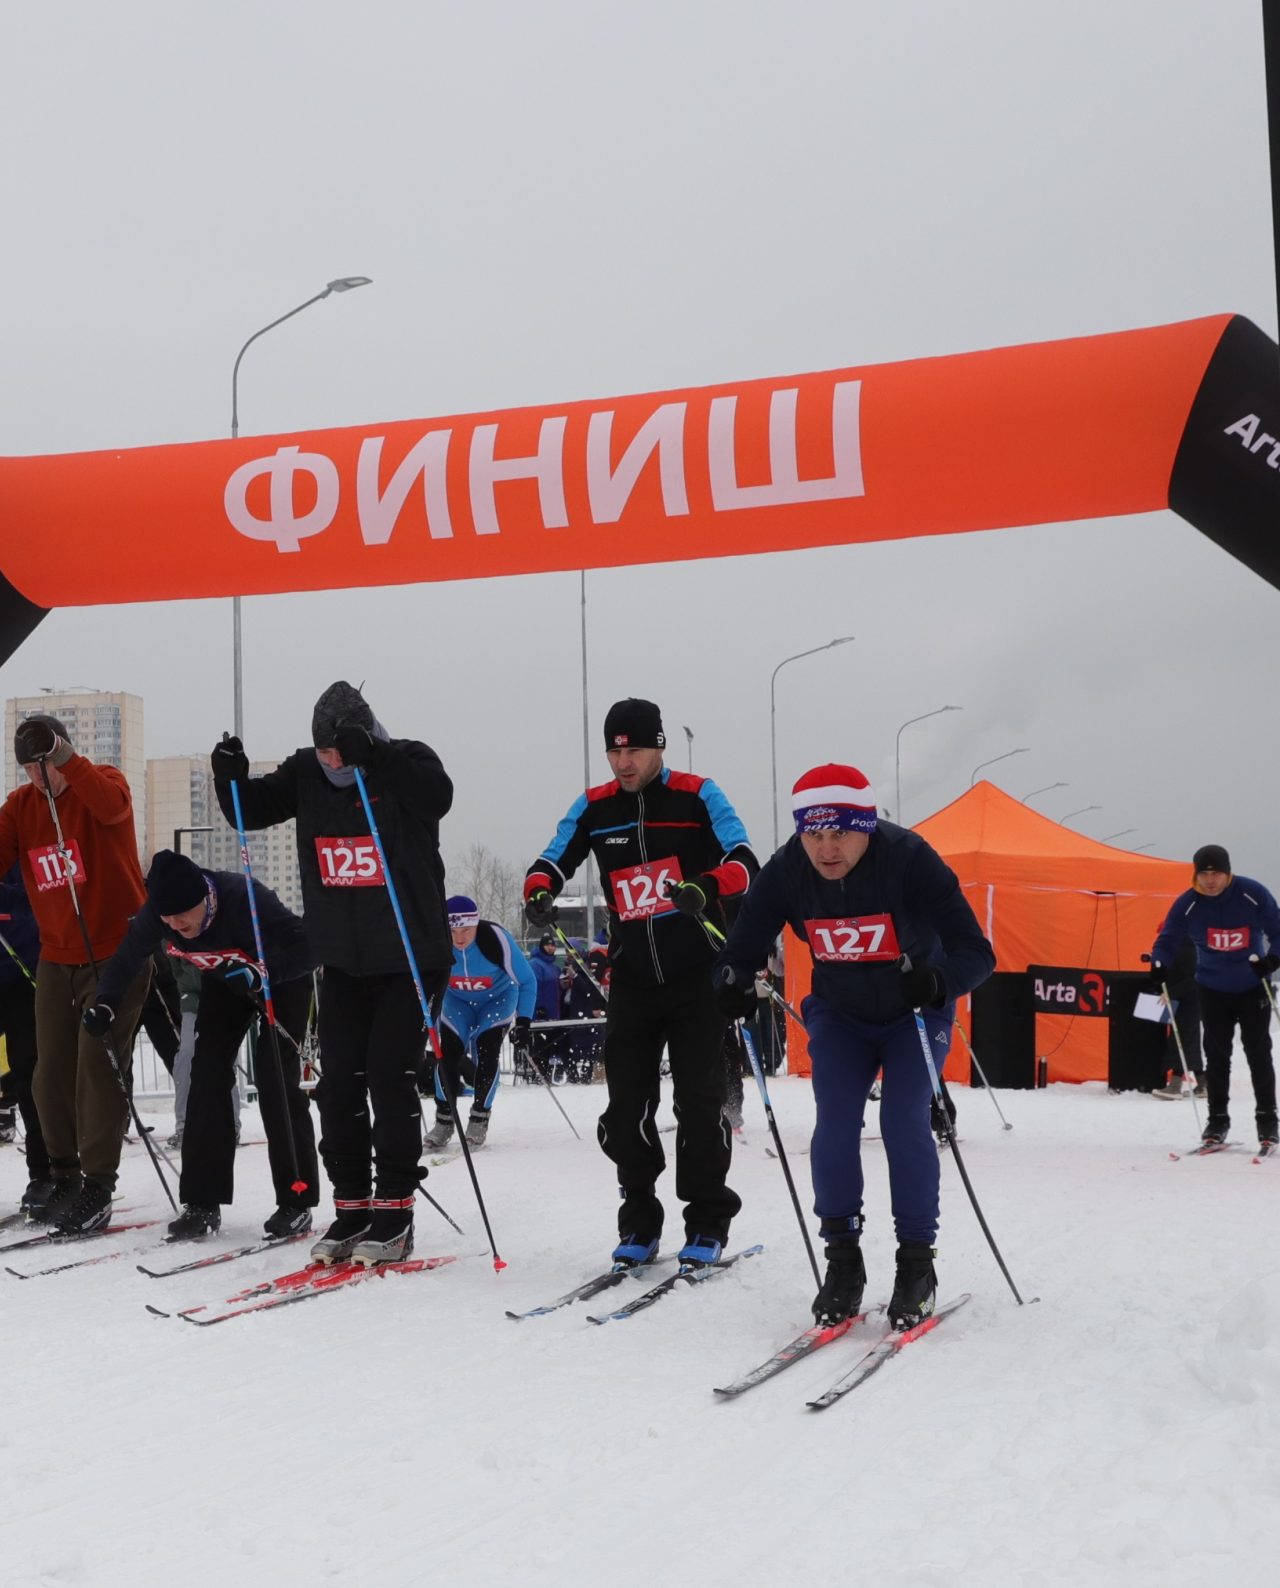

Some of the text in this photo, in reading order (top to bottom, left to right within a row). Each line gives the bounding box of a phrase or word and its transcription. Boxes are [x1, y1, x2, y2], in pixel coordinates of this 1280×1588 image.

[1223, 413, 1280, 473] Art
[223, 379, 866, 553] ФИНИШ
[37, 848, 77, 882] 113
[321, 846, 377, 877] 125
[616, 869, 678, 910] 126
[815, 924, 886, 954] 127
[1212, 932, 1244, 949] 112
[1034, 978, 1077, 1003] Arta
